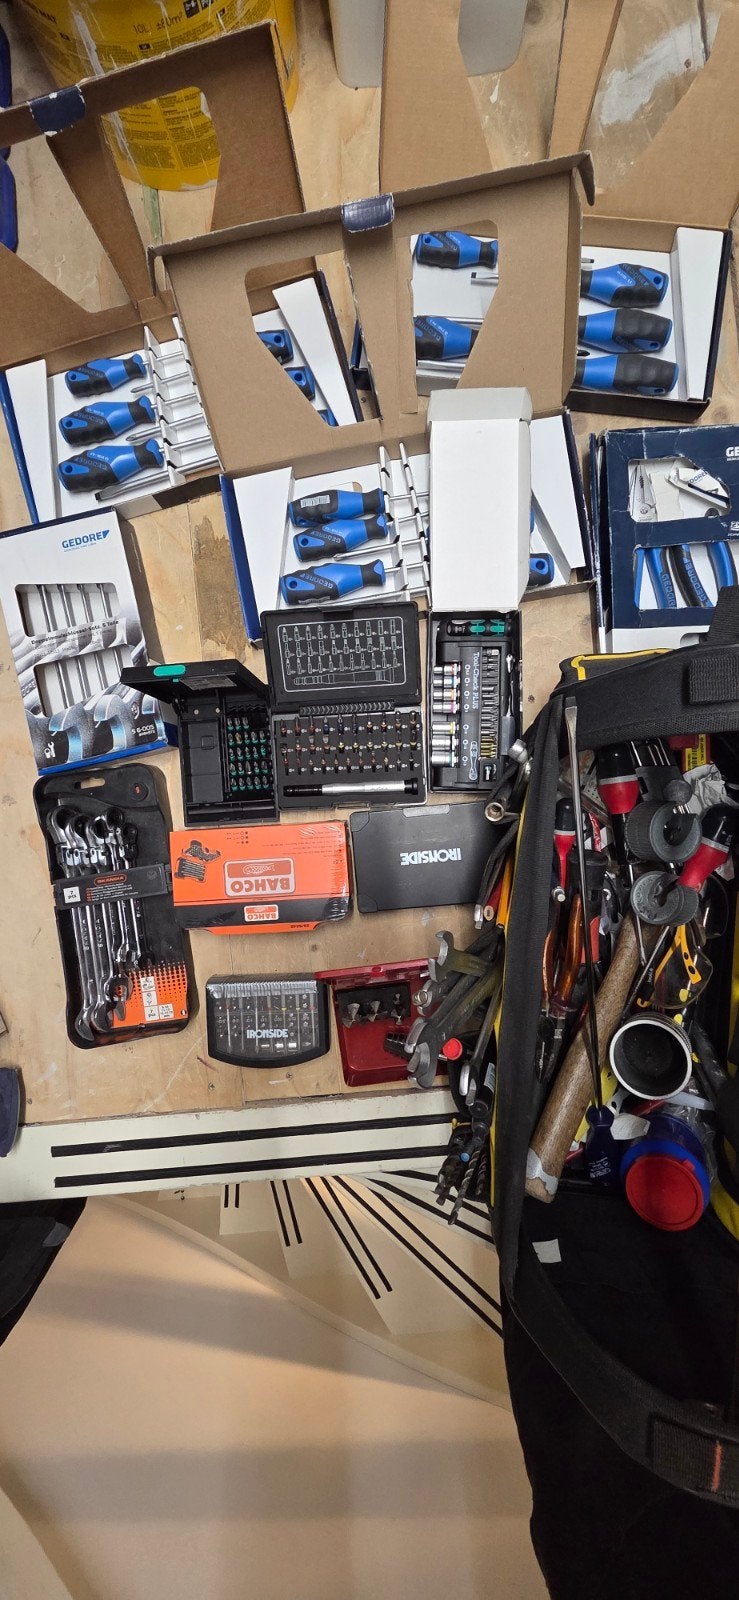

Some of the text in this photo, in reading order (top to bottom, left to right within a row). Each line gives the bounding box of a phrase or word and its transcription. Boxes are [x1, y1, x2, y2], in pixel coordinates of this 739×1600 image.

[62, 531, 102, 549] GEDORE
[472, 652, 480, 691] Tool-Check
[399, 847, 462, 866] IRONSIDE
[230, 877, 291, 893] BAHCO
[247, 912, 277, 921] BAHCO
[246, 1028, 289, 1039] IRONSIDE
